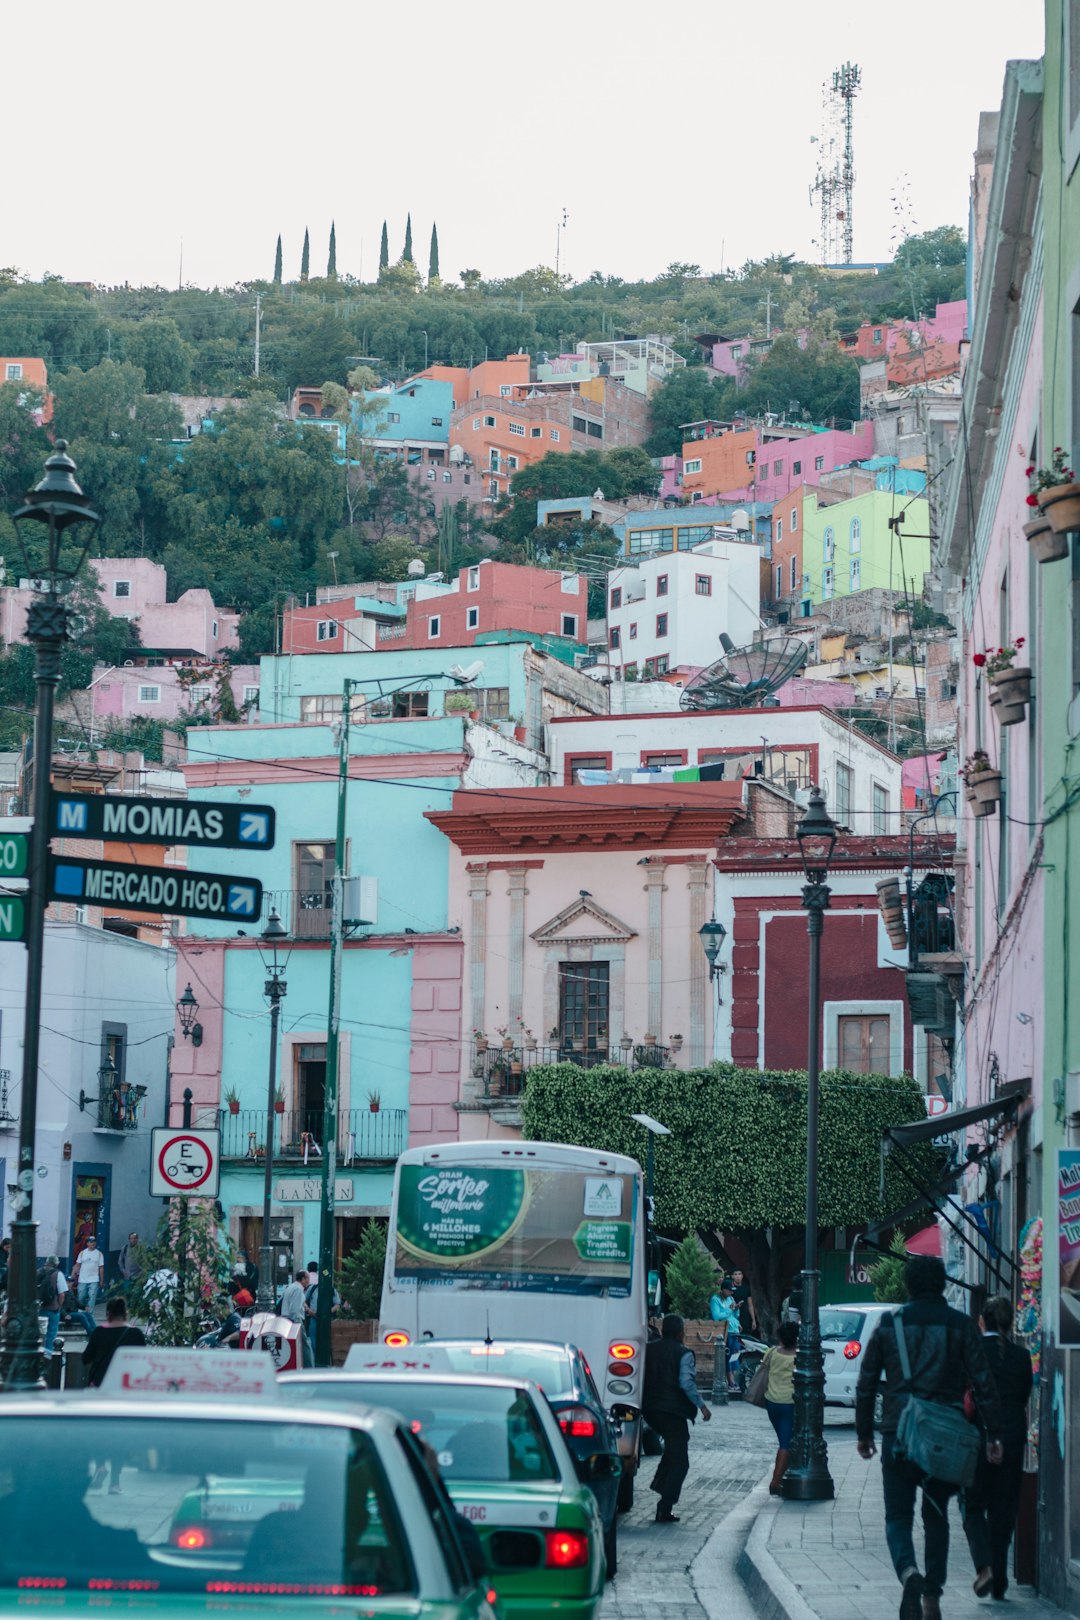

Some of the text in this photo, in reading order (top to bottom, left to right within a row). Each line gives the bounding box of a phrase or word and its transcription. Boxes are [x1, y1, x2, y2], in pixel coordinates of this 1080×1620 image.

[60, 801, 224, 840] M MOMIAS
[0, 840, 18, 870] O
[85, 867, 226, 913] MERCADO HGO.
[180, 1143, 192, 1158] E
[438, 1171, 463, 1179] GRAN
[303, 1180, 323, 1189] FOT
[417, 1175, 490, 1201] Sorteo
[431, 1198, 484, 1214] millonario
[423, 1222, 481, 1233] 6 MILLONES
[587, 1223, 618, 1233] Ingresa
[587, 1232, 616, 1241] Ahorra
[436, 1239, 466, 1247] EFECTIVO
[587, 1240, 618, 1249] Tramita
